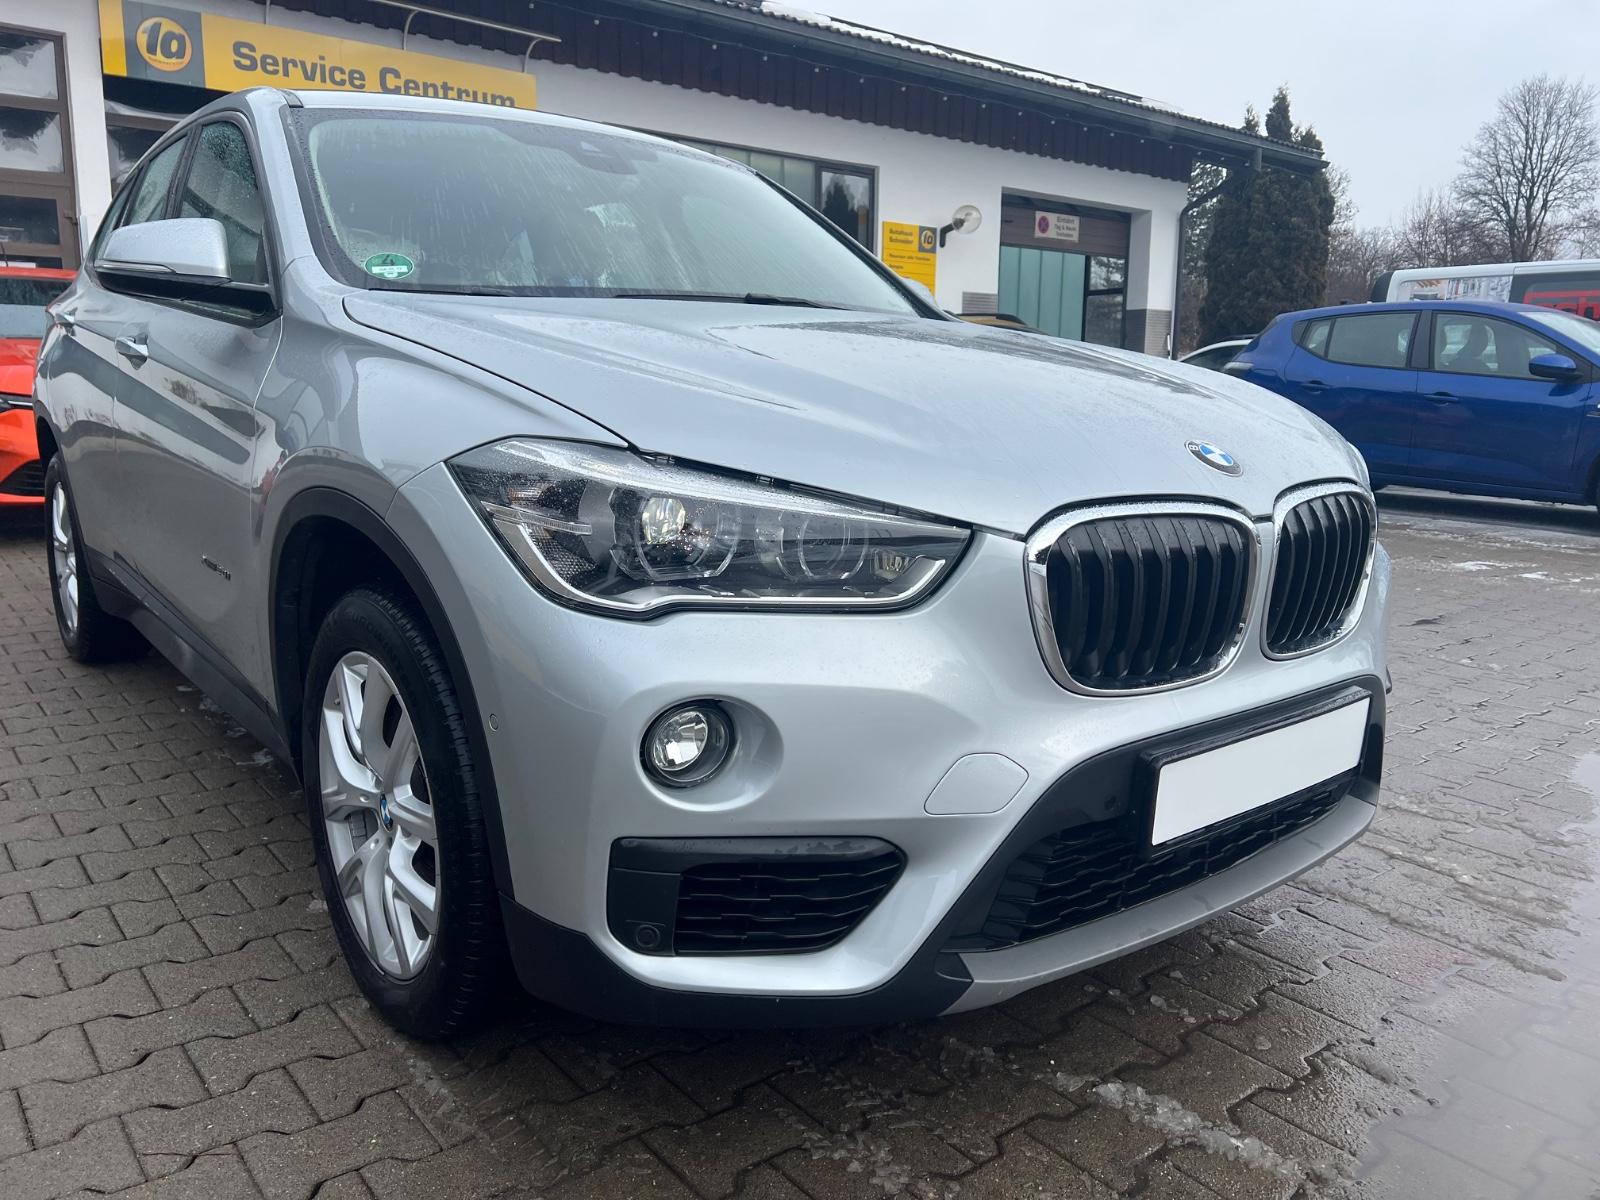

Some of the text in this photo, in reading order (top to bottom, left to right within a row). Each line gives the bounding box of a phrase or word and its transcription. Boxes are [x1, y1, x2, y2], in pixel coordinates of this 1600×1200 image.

[143, 22, 187, 59] 1a
[233, 40, 516, 107] Service Centrum
